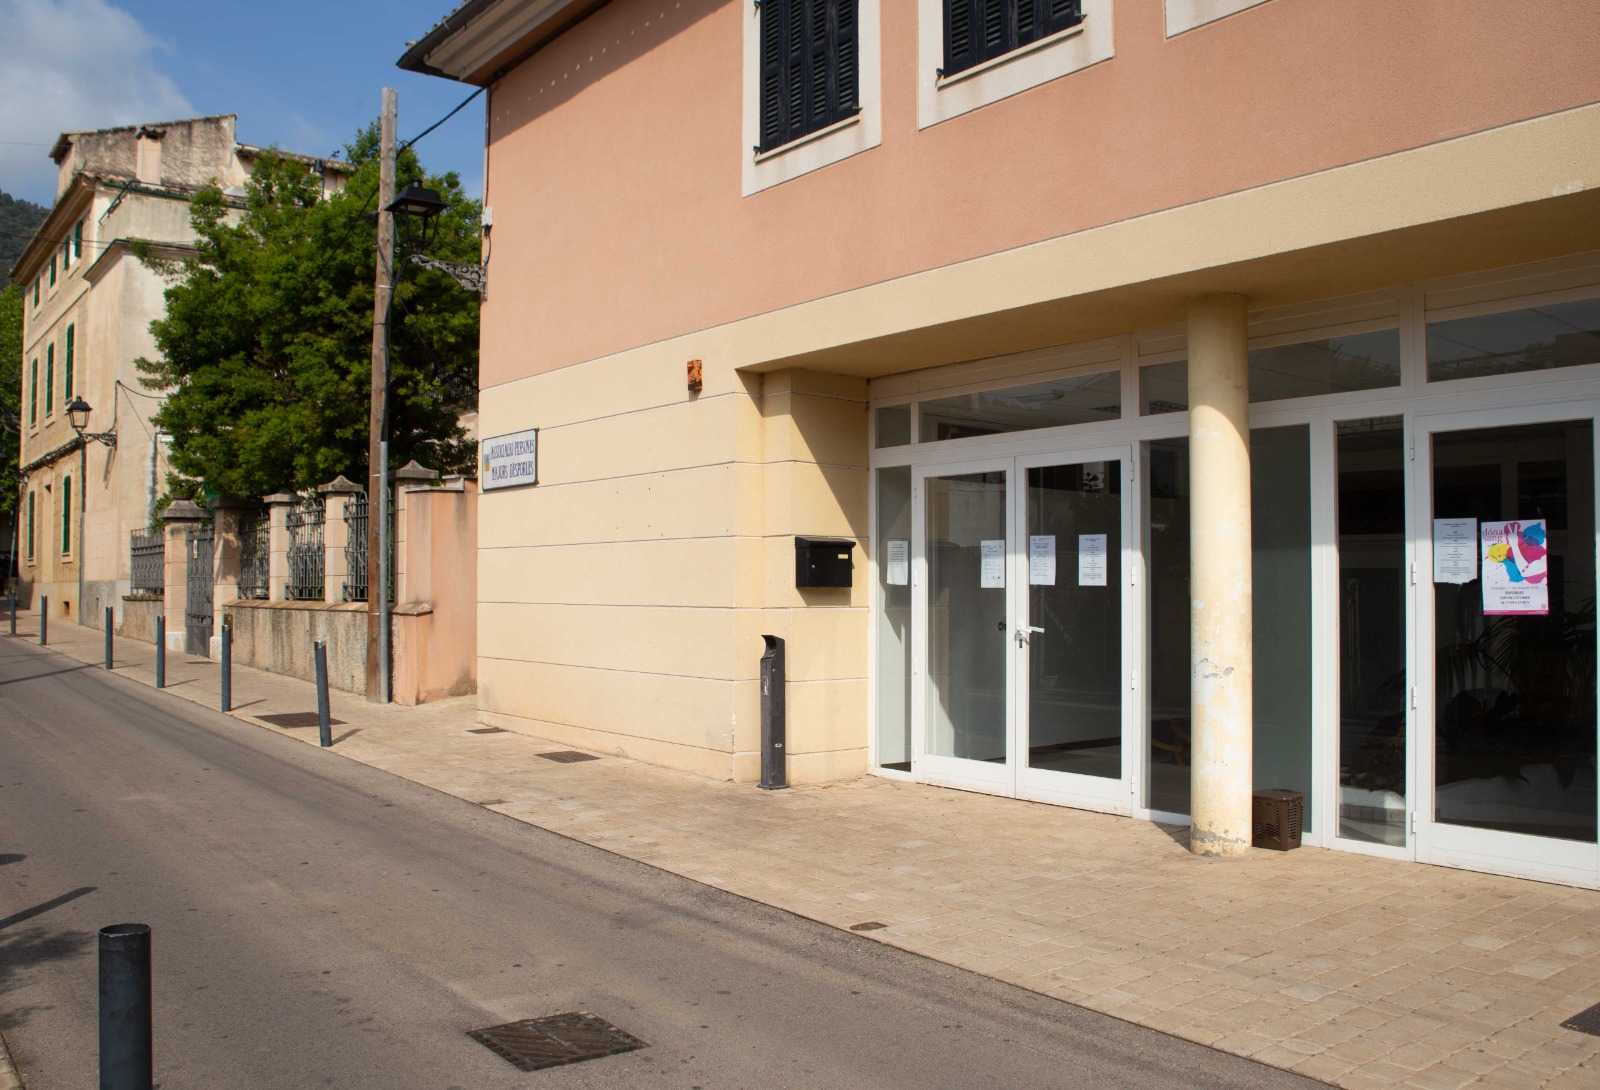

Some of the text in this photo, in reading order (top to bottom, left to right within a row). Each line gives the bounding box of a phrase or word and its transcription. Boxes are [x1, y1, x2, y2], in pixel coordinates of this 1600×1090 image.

[514, 439, 535, 456] PERSONES
[491, 465, 508, 480] MAJORS
[1482, 528, 1503, 536] dóna
[1482, 535, 1503, 544] sang
